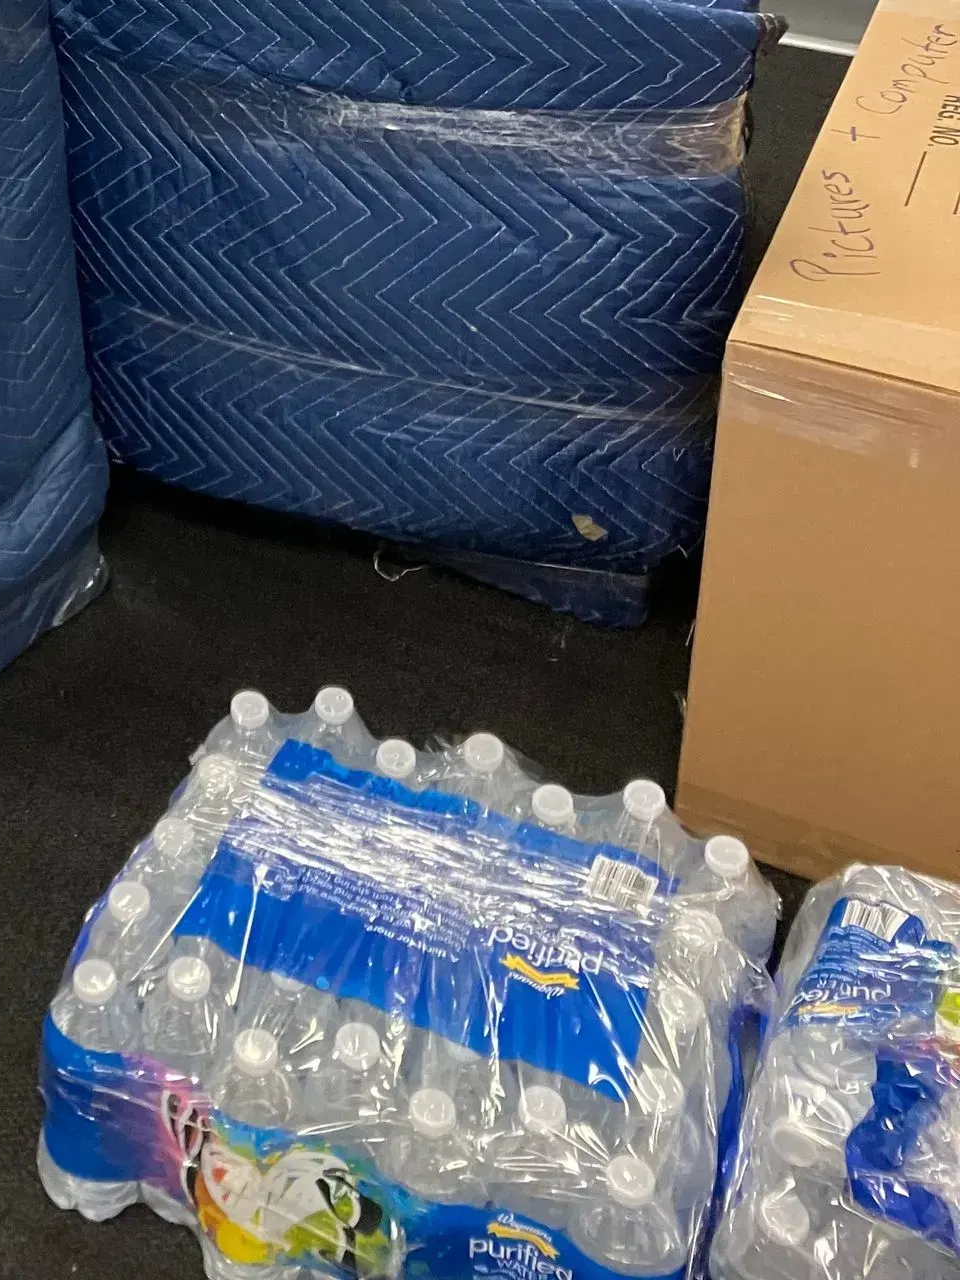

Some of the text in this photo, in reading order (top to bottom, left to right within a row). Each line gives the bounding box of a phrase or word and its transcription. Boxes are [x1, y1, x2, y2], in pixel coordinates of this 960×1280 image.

[790, 169, 880, 282] Pictures
[856, 23, 958, 115] Computer
[509, 971, 566, 1000] Wegmans
[469, 1236, 573, 1280] purified
